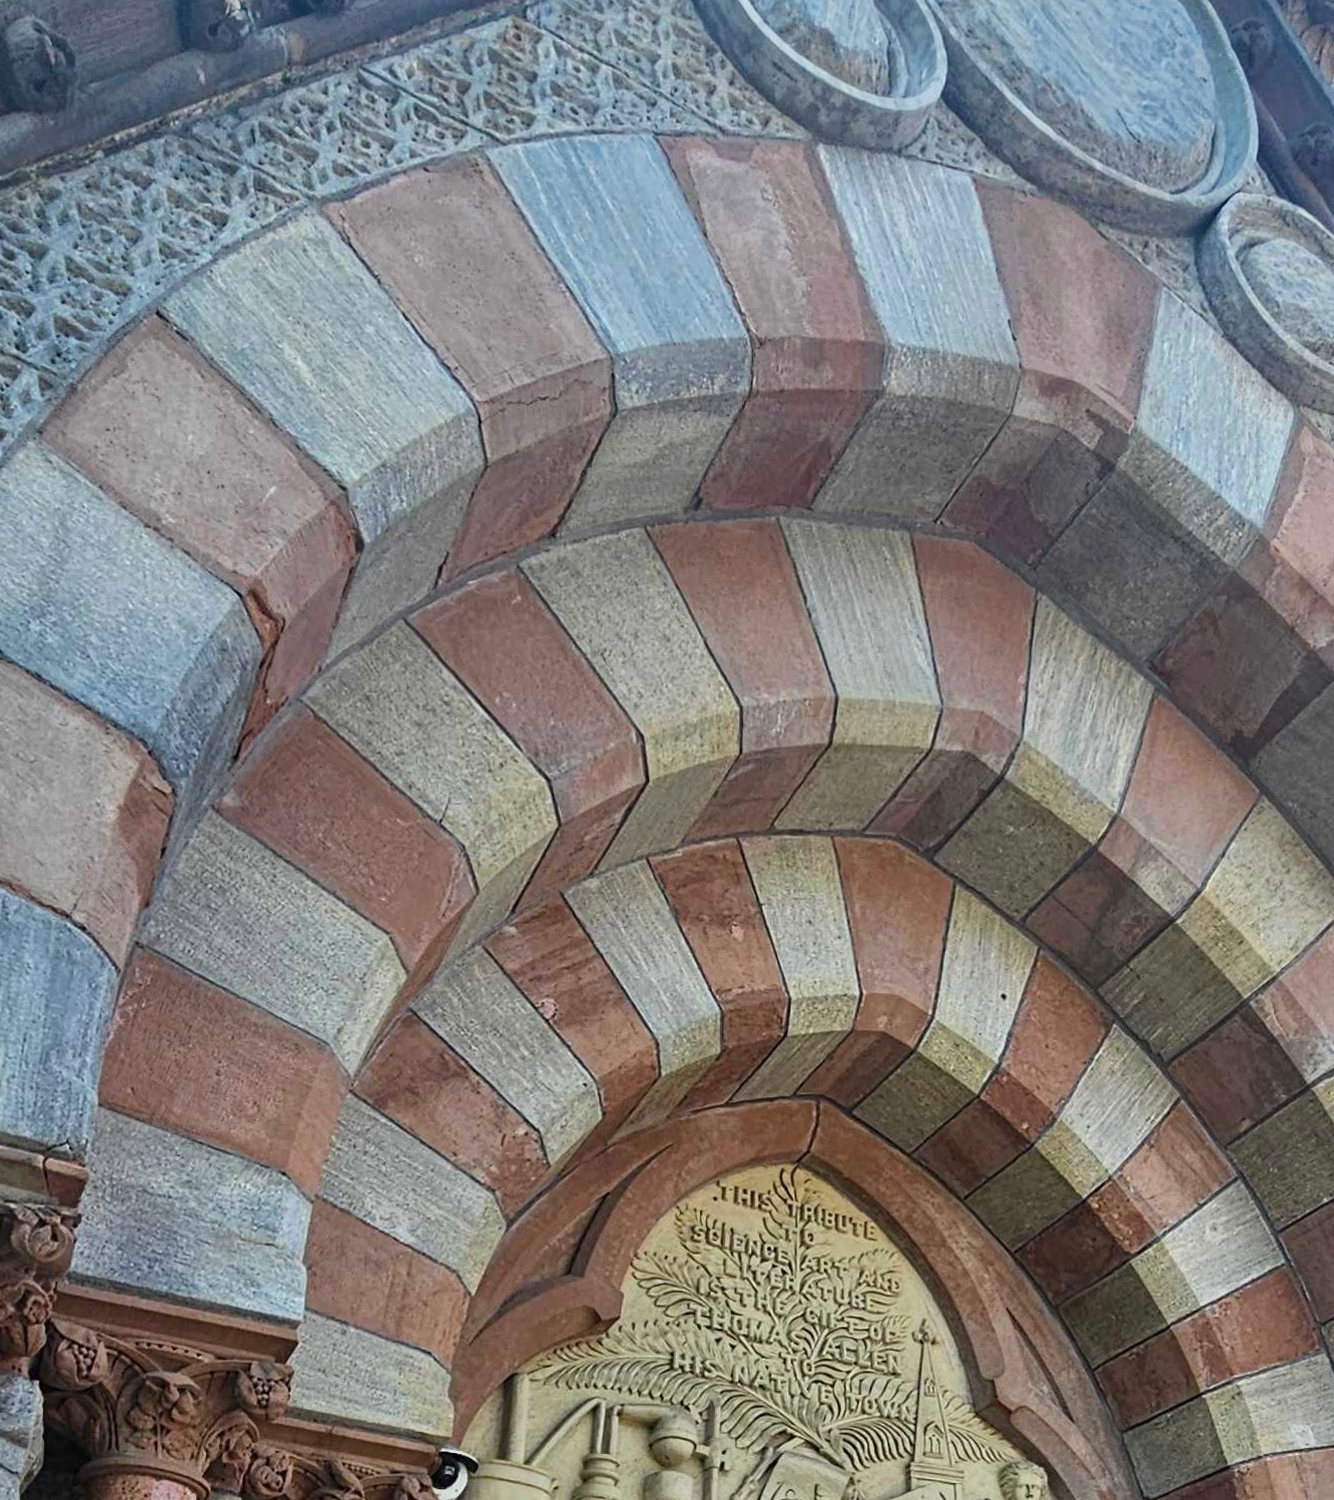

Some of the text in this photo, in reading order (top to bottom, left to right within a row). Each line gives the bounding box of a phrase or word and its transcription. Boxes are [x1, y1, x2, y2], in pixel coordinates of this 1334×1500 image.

[717, 1182, 878, 1241] THIS TRIBUTE
[782, 1223, 816, 1245] TO
[690, 1223, 901, 1293] SCIENCE ART AND
[697, 1277, 725, 1298] IS
[733, 1287, 788, 1317] THE
[689, 1304, 902, 1377] THOMAS ALLEN
[779, 1351, 817, 1376] TO
[671, 1349, 917, 1427] HIS NATIVE TOWN
